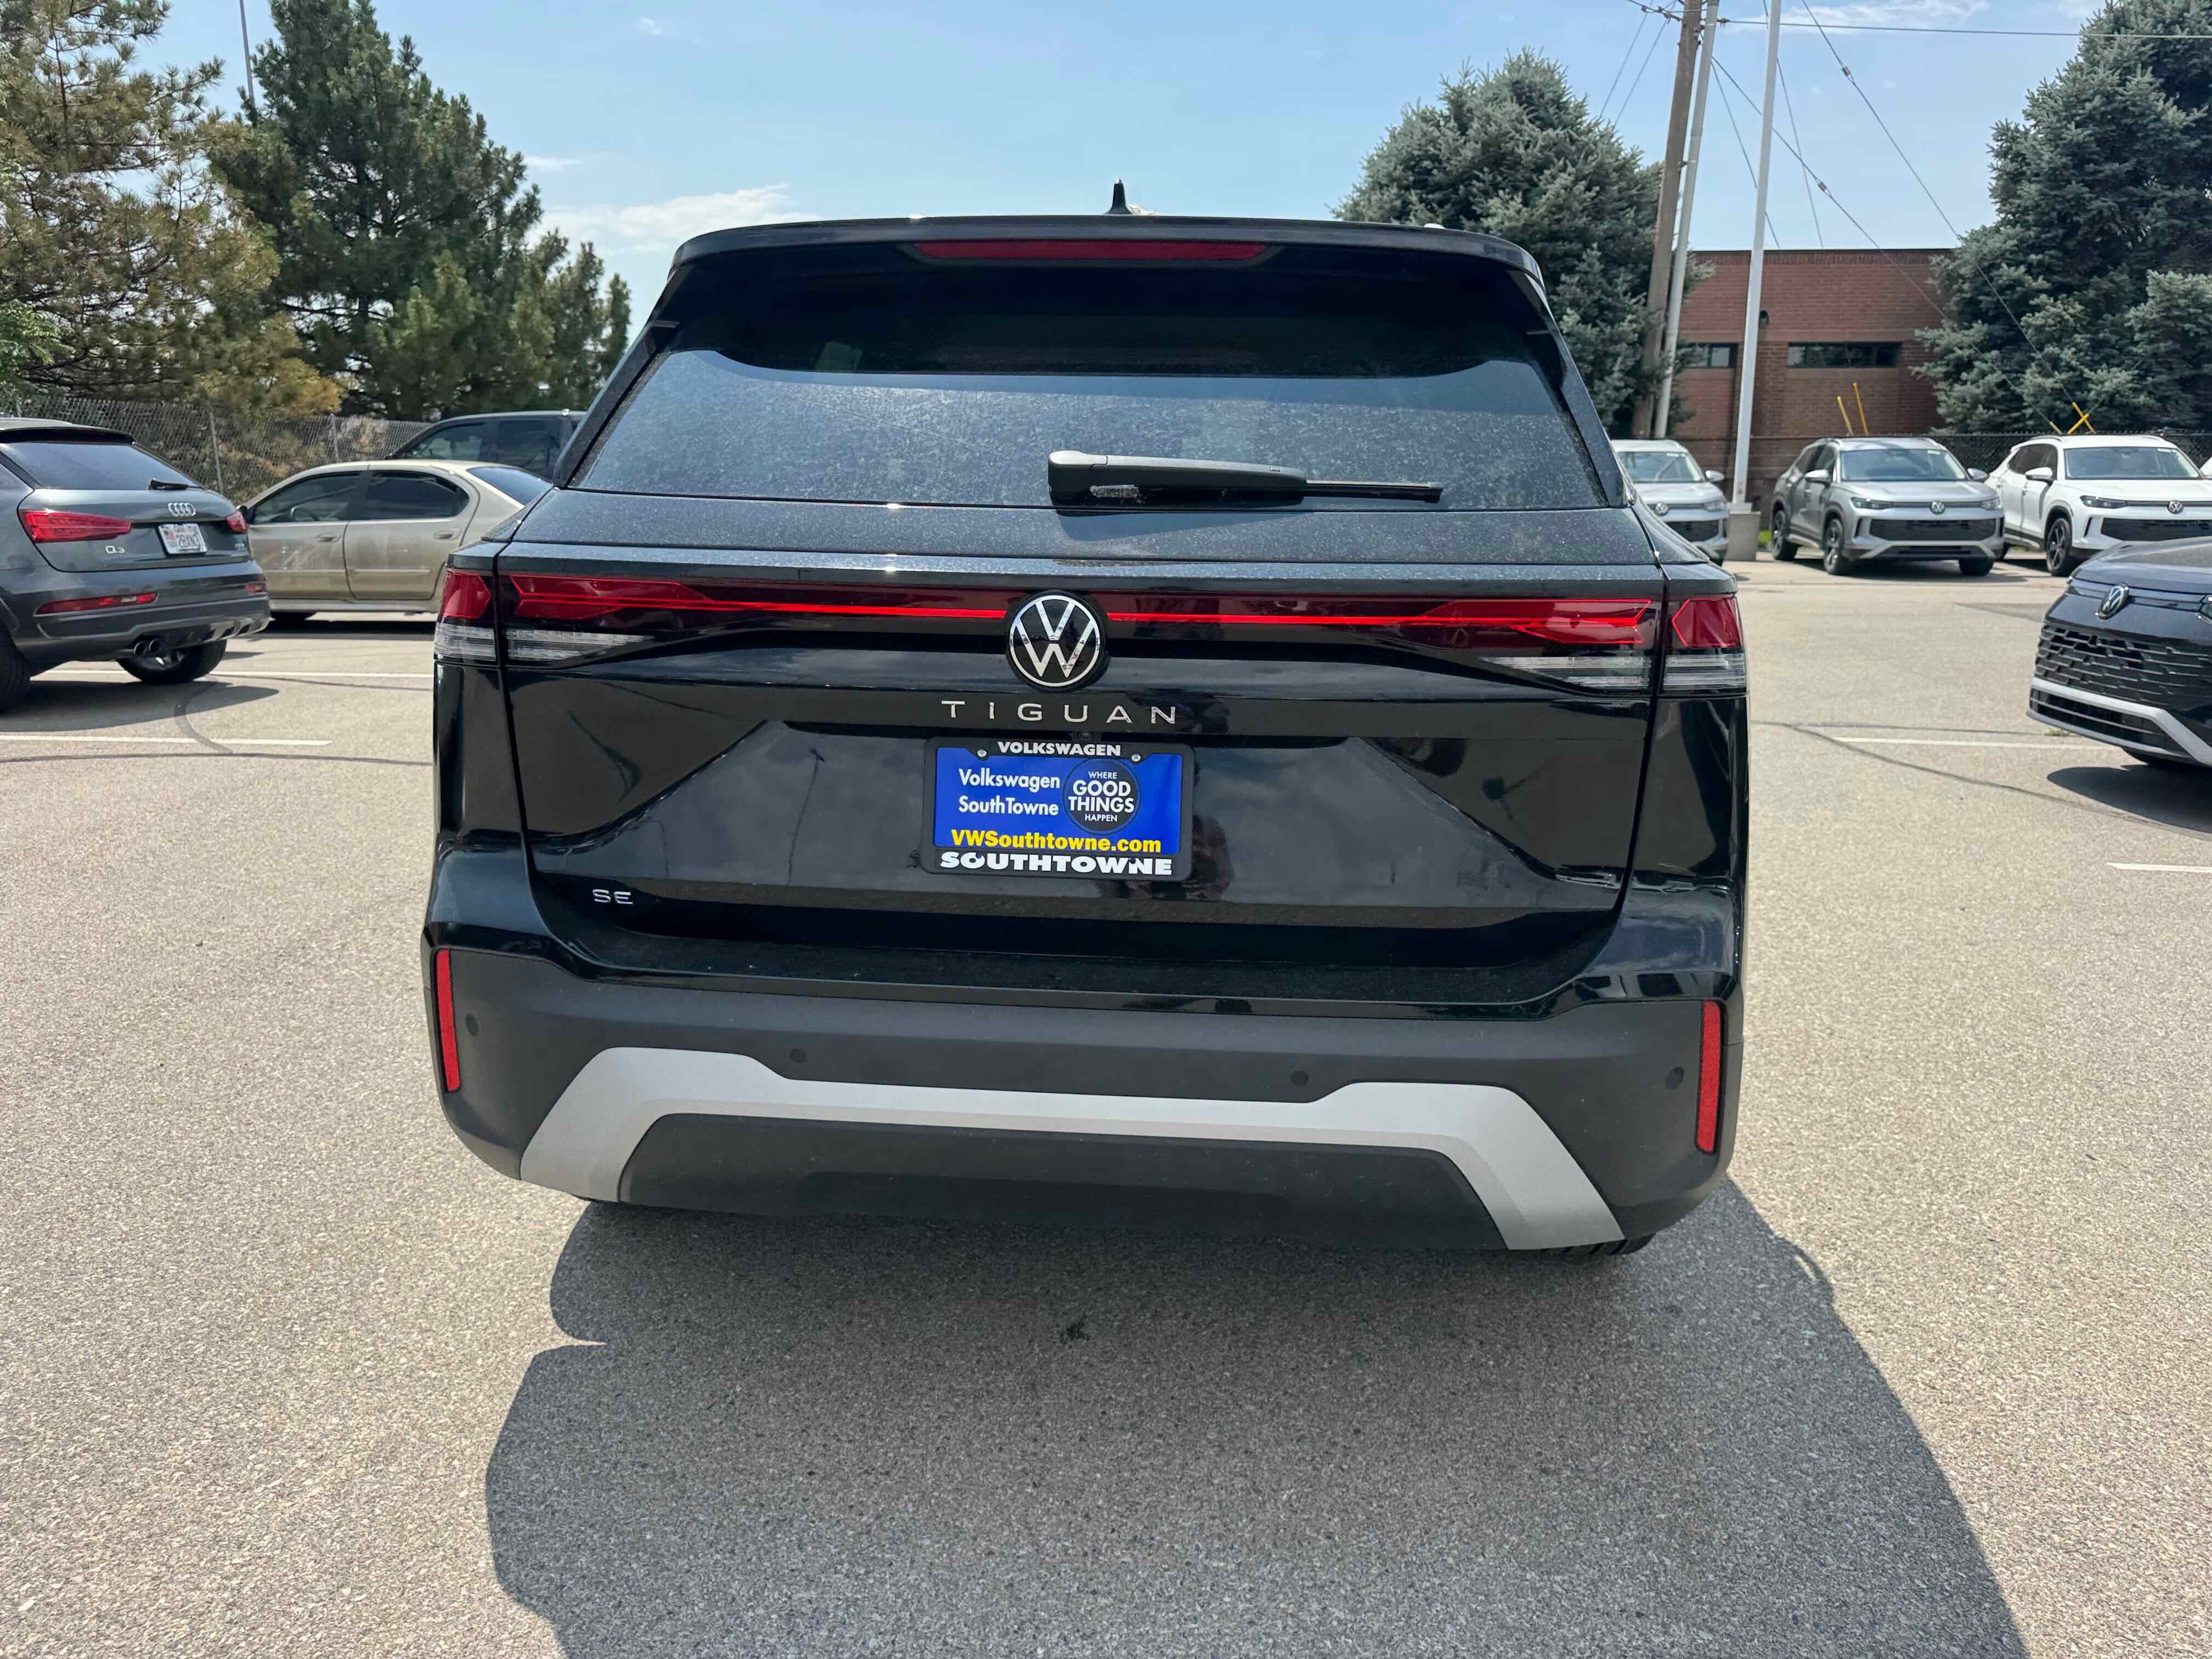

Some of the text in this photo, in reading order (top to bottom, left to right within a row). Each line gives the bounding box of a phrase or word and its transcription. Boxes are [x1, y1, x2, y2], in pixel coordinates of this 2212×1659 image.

[105, 545, 125, 554] Q3
[1011, 596, 1099, 684] VW
[941, 700, 1176, 724] TIGUAN
[997, 741, 1121, 756] VOLKSWAGEN
[958, 768, 1060, 792] Volkswagen
[1088, 771, 1118, 780] WHERE
[1073, 780, 1131, 797] GOOD
[1068, 795, 1135, 814] THINGS
[1085, 813, 1118, 822] HAPPEN
[951, 829, 1161, 853] VWSouthtowne.com
[940, 851, 1172, 876] SOUTHTOWNE
[592, 889, 633, 904] SE
